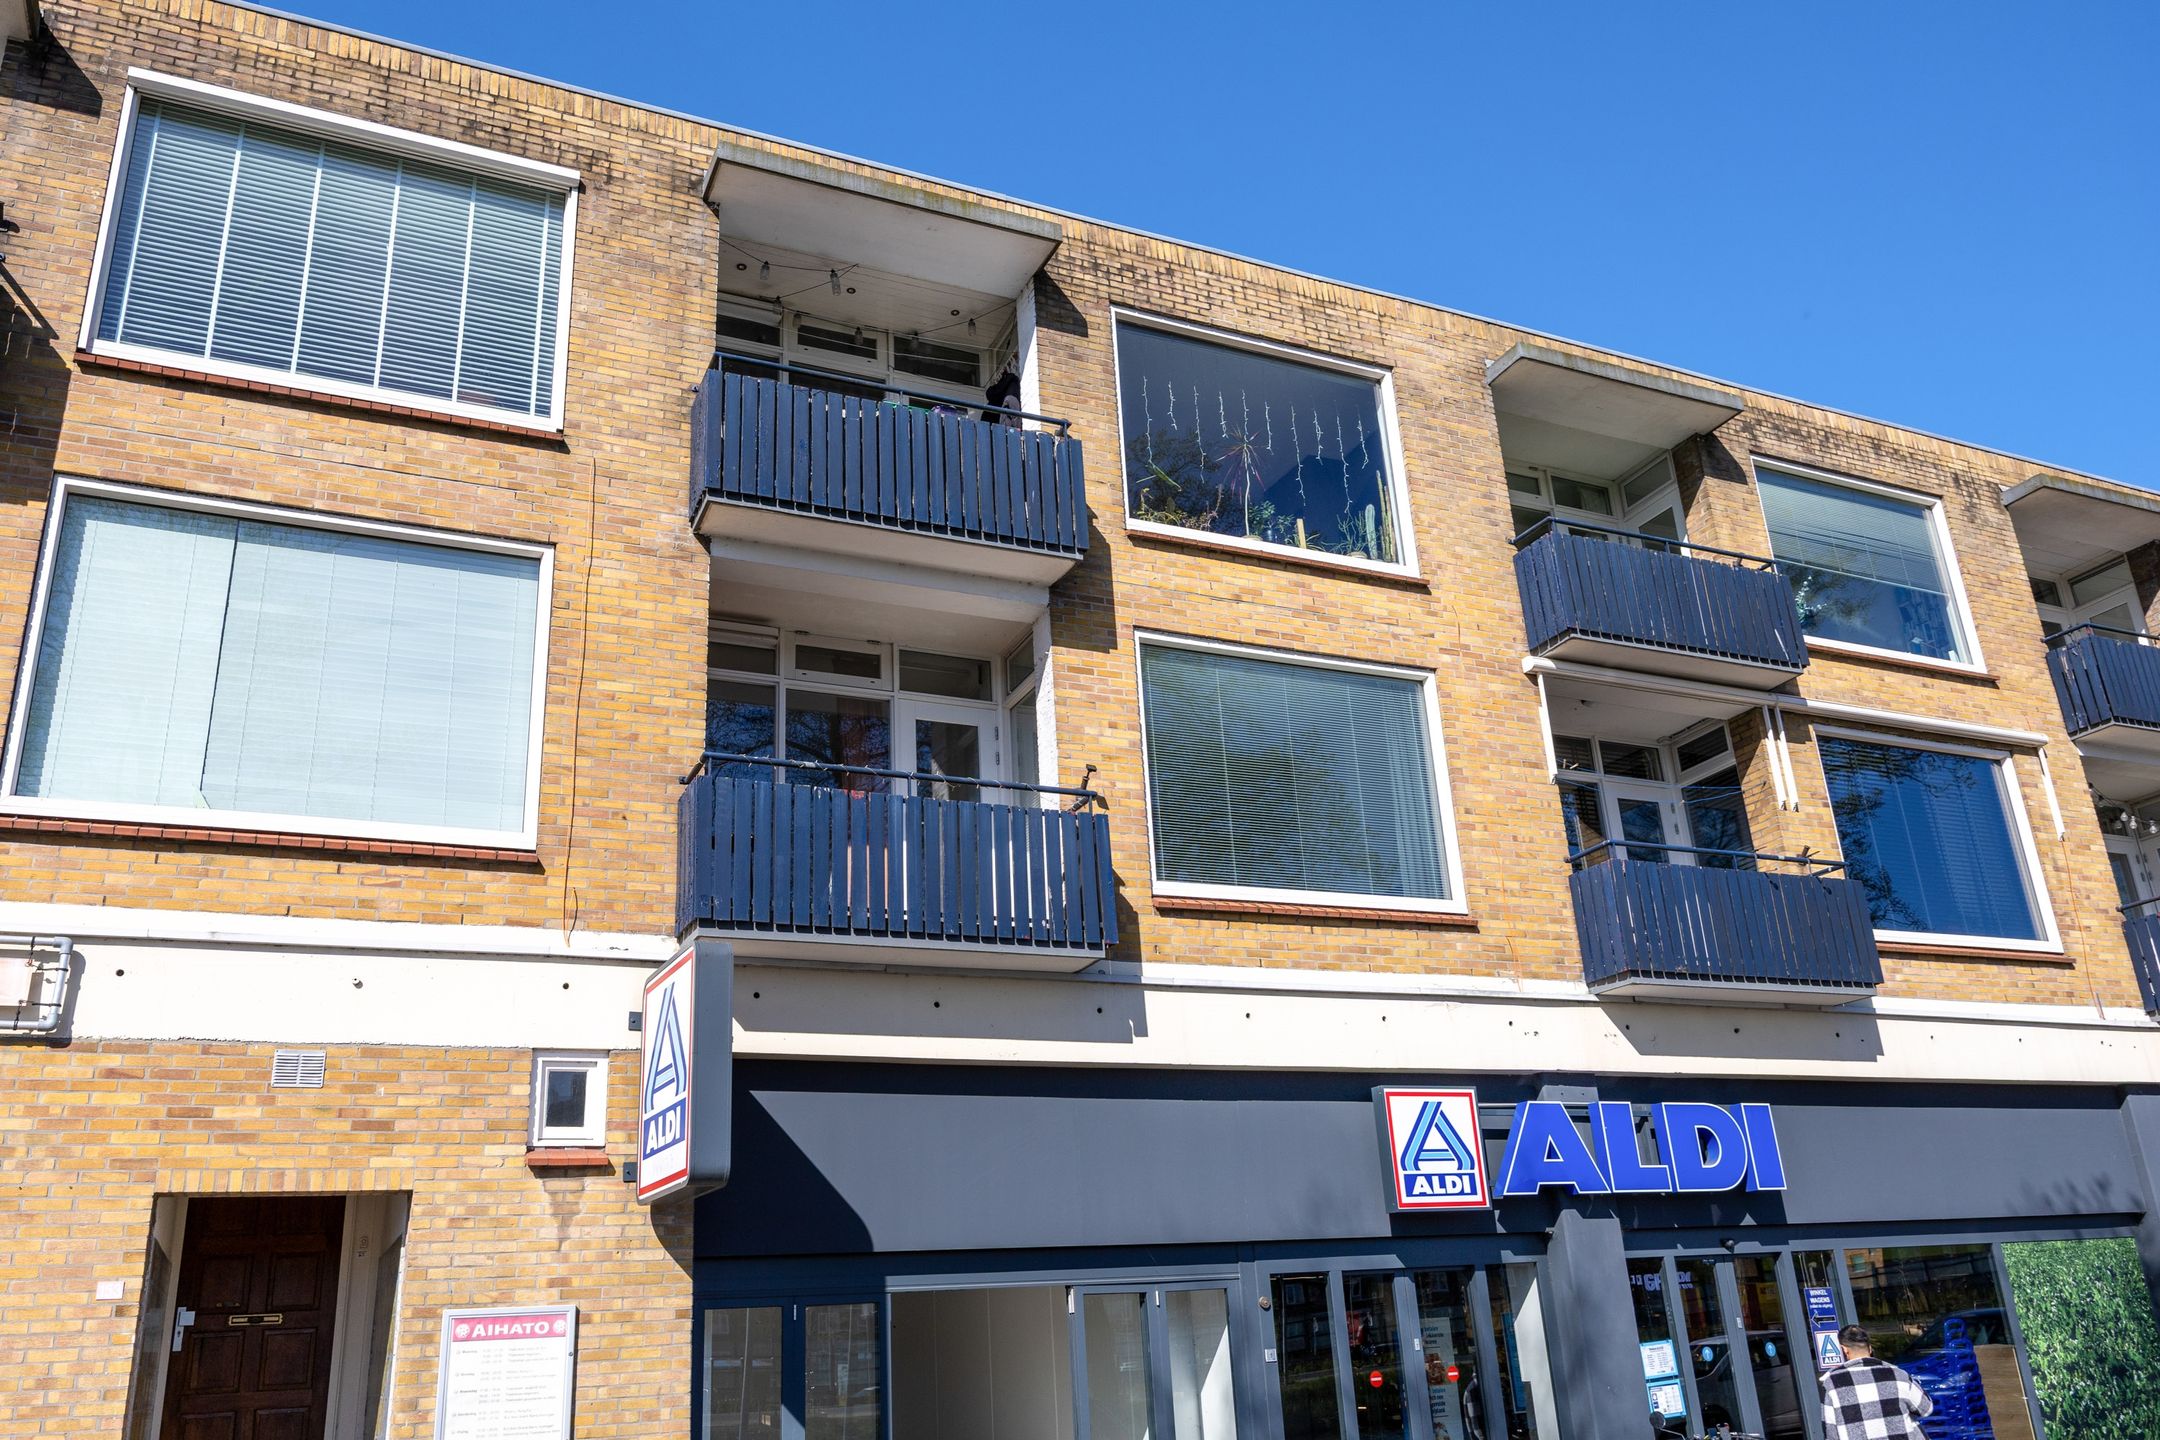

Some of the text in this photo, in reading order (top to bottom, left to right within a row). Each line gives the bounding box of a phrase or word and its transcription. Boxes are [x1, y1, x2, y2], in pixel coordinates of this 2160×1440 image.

[645, 1105, 682, 1155] ALDI
[1497, 1100, 1788, 1196] ALDI
[1412, 1174, 1471, 1195] ALDI
[1809, 1296, 1831, 1304] WAGENS
[471, 1321, 550, 1338] AIHATO
[1824, 1356, 1841, 1364] ALDI
